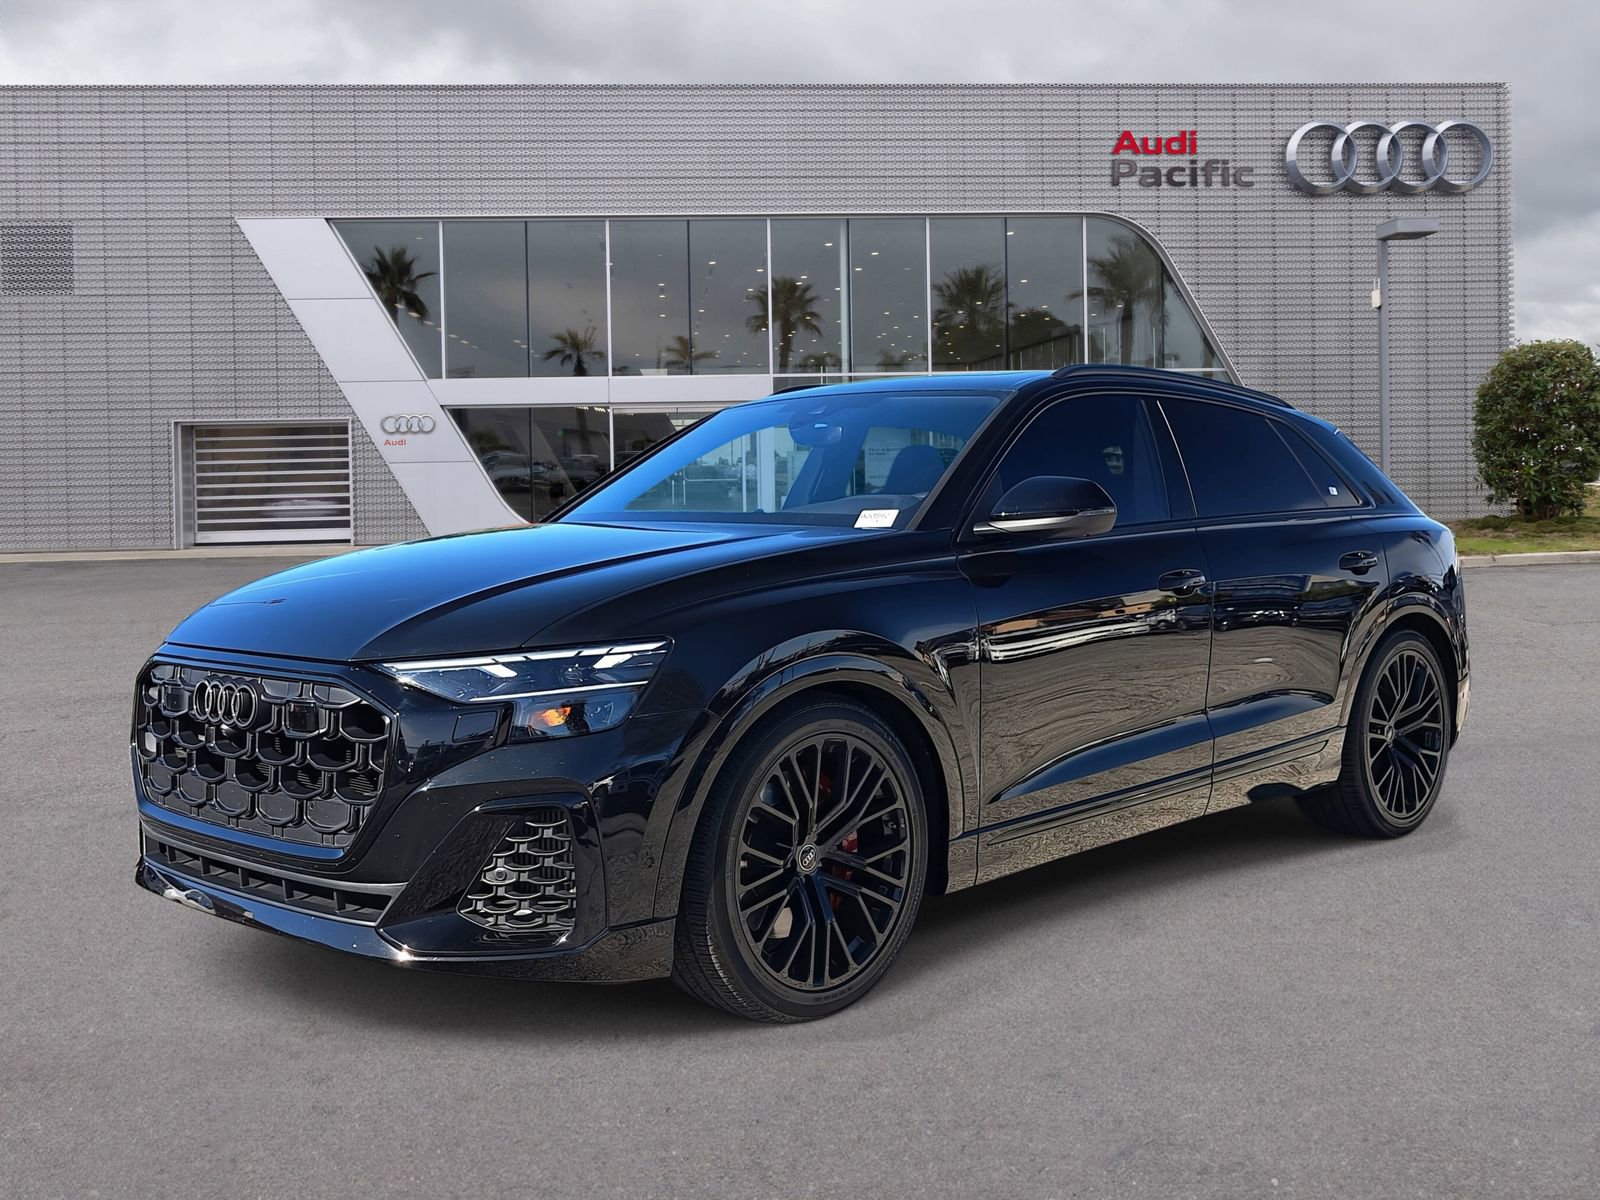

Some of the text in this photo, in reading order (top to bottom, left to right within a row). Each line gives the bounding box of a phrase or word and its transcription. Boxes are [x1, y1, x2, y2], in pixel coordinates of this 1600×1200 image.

[1112, 130, 1198, 155] Audi
[1111, 159, 1255, 187] Pacific
[384, 438, 407, 446] Audi
